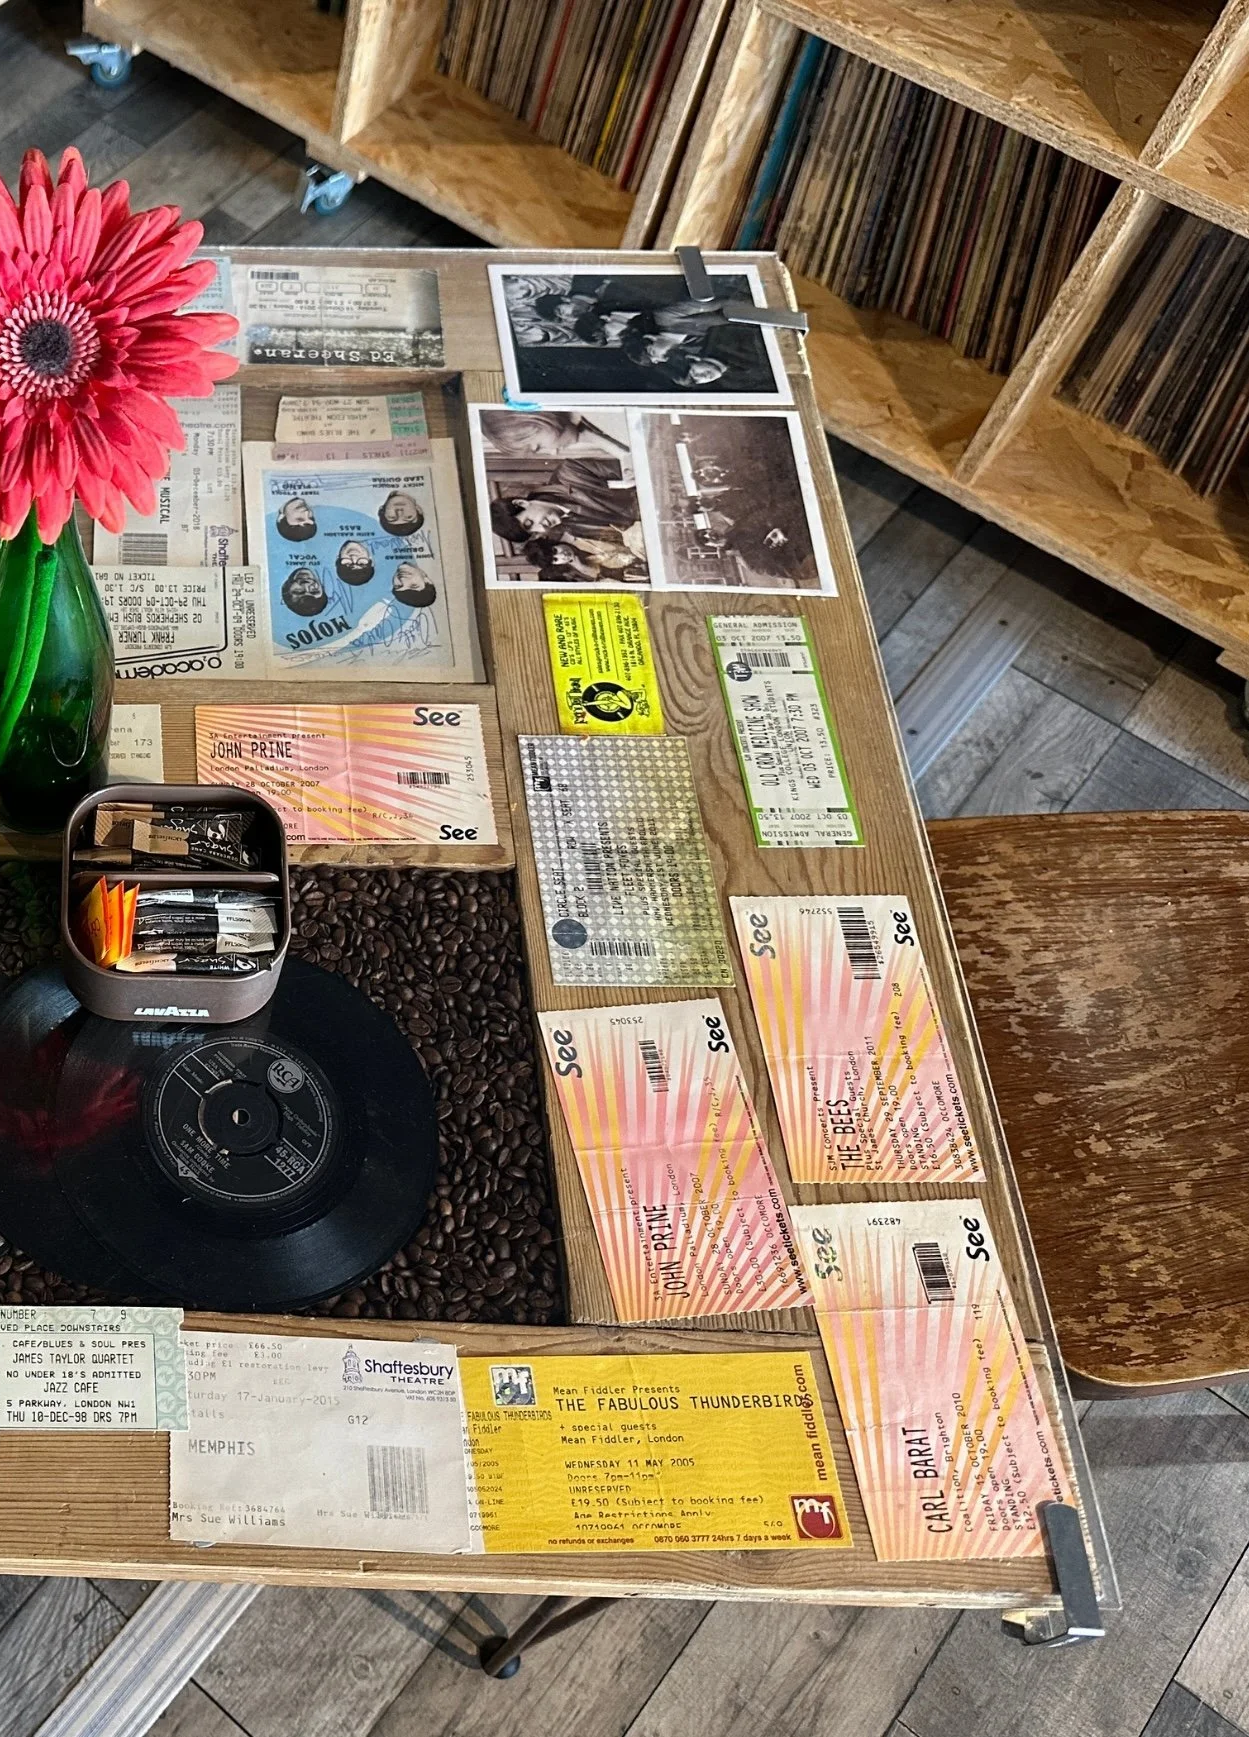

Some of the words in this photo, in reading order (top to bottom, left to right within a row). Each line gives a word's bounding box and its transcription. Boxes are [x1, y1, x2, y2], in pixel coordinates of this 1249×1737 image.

[370, 351, 395, 362] Ed
[160, 487, 171, 524] MUSICAL
[554, 614, 565, 633] RARE
[118, 632, 146, 643] TURNER
[153, 633, 175, 644] FRANK
[557, 635, 567, 652] AND
[560, 655, 570, 667] NEW
[742, 695, 761, 712] SHOW
[413, 707, 460, 727] See
[745, 716, 773, 750] MEDICINE
[211, 742, 242, 759] JOHN
[252, 742, 293, 759] PRINE
[756, 753, 777, 771] CROW
[762, 773, 780, 787] OLD
[440, 825, 477, 840] See
[622, 870, 634, 896] FLEET
[750, 914, 776, 959] See
[894, 912, 914, 947] See
[134, 1007, 209, 1018] LAVAZZA
[705, 1016, 730, 1053] See
[865, 1036, 875, 1055] 2011
[554, 1030, 583, 1078] See
[271, 1063, 301, 1090] RCA
[872, 1061, 890, 1107] SEPTEMBER
[827, 1099, 856, 1135] BEES
[946, 1073, 980, 1173] www.seetickets.com
[180, 1140, 194, 1155] SAM
[194, 1152, 215, 1174] COOKE
[183, 1123, 197, 1138] ONE
[196, 1136, 213, 1154] MORE
[214, 1152, 231, 1169] TIME
[834, 1145, 865, 1170] THE
[892, 1129, 905, 1170] THURSDAY
[914, 1127, 929, 1170] STANDING
[274, 1158, 295, 1178] 1277
[276, 1146, 304, 1176] 45-RCA
[643, 1204, 675, 1252] PRINE
[962, 1217, 990, 1262] See
[768, 1188, 806, 1295] www.seetickets.com
[813, 1227, 843, 1281] See
[664, 1260, 690, 1299] JOHN
[13, 1354, 43, 1364] JAMES
[50, 1354, 86, 1364] TAYLOR
[92, 1354, 134, 1365] QUARTET
[364, 1359, 454, 1379] Shaftesbury
[44, 1383, 69, 1394] JAZZ
[74, 1383, 99, 1394] CAFE
[390, 1376, 445, 1385] THEATRE
[554, 1387, 579, 1395] Mean
[584, 1385, 627, 1395] Fiddler
[632, 1385, 680, 1395] Presents
[556, 1397, 586, 1412] THE
[598, 1396, 679, 1411] FABULOUS
[952, 1393, 967, 1417] 2010
[7, 1412, 25, 1422] THU
[32, 1412, 87, 1423] 10-DEC-98
[93, 1412, 112, 1422] DRS
[118, 1413, 137, 1423] 7PM
[348, 1416, 369, 1425] G12
[188, 1440, 255, 1455] MEMPHIS
[935, 1412, 953, 1463] Brighton
[962, 1423, 979, 1468] OCTOBER
[902, 1427, 938, 1479] BARAT
[810, 1452, 827, 1481] mean
[172, 1513, 193, 1522] Mrs
[201, 1515, 221, 1524] Sue
[229, 1515, 285, 1526] Williams
[928, 1490, 953, 1533] CARL
